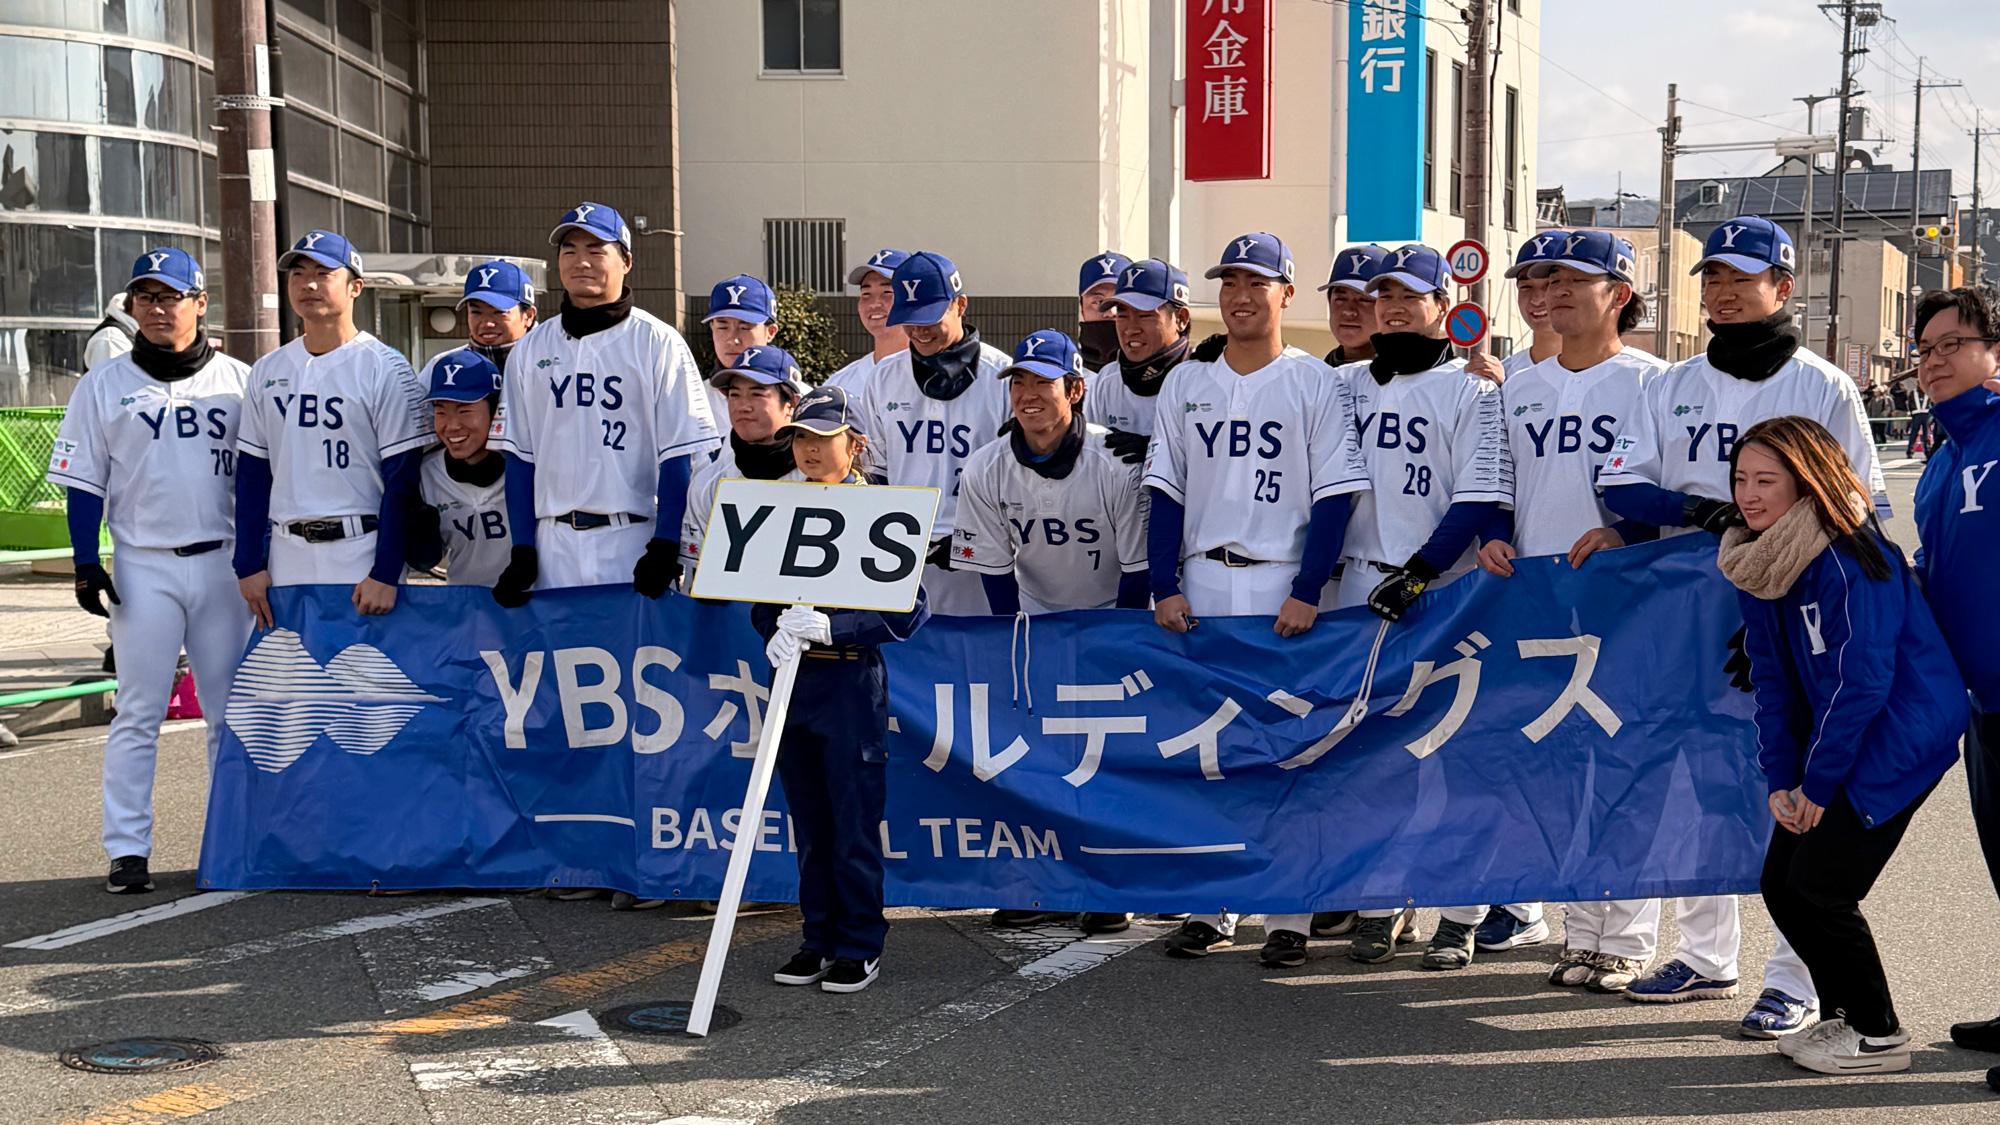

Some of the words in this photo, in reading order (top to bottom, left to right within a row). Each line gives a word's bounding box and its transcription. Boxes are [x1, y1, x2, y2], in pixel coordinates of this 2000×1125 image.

[573, 204, 596, 224] Y
[305, 234, 326, 250] Y
[1531, 236, 1554, 257] Y
[1561, 234, 1586, 255] Y
[1721, 225, 1747, 247] Y
[873, 249, 893, 266] Y
[1236, 239, 1259, 259] Y
[1394, 249, 1417, 268] Y
[148, 252, 169, 271] Y
[1098, 258, 1117, 275] Y
[1350, 254, 1372, 275] Y
[1455, 252, 1479, 272] 40
[479, 269, 499, 287] Y
[1125, 269, 1145, 287] Y
[725, 285, 747, 305] Y
[902, 280, 921, 301] Y
[739, 348, 761, 366] Y
[1024, 337, 1046, 357] Y
[444, 364, 463, 385] Y
[550, 373, 622, 410] YBS
[274, 394, 343, 430] YBS
[139, 407, 227, 440] YBS
[1354, 412, 1429, 454] YBS
[602, 420, 627, 451] 22
[897, 420, 970, 458] YBS
[1195, 421, 1282, 459] YBS
[1525, 415, 1617, 458] YBS
[1686, 422, 1739, 462] YB
[210, 448, 233, 476] 70
[323, 439, 349, 469] 18
[1254, 469, 1282, 503] 25
[1402, 463, 1432, 497] 28
[1960, 460, 1999, 514] Y
[453, 510, 507, 541] YB
[1010, 518, 1100, 546] YBS
[720, 503, 922, 583] YBS
[1087, 550, 1101, 571] 7
[651, 807, 907, 858] BASEL
[919, 817, 1064, 861] TEAM
